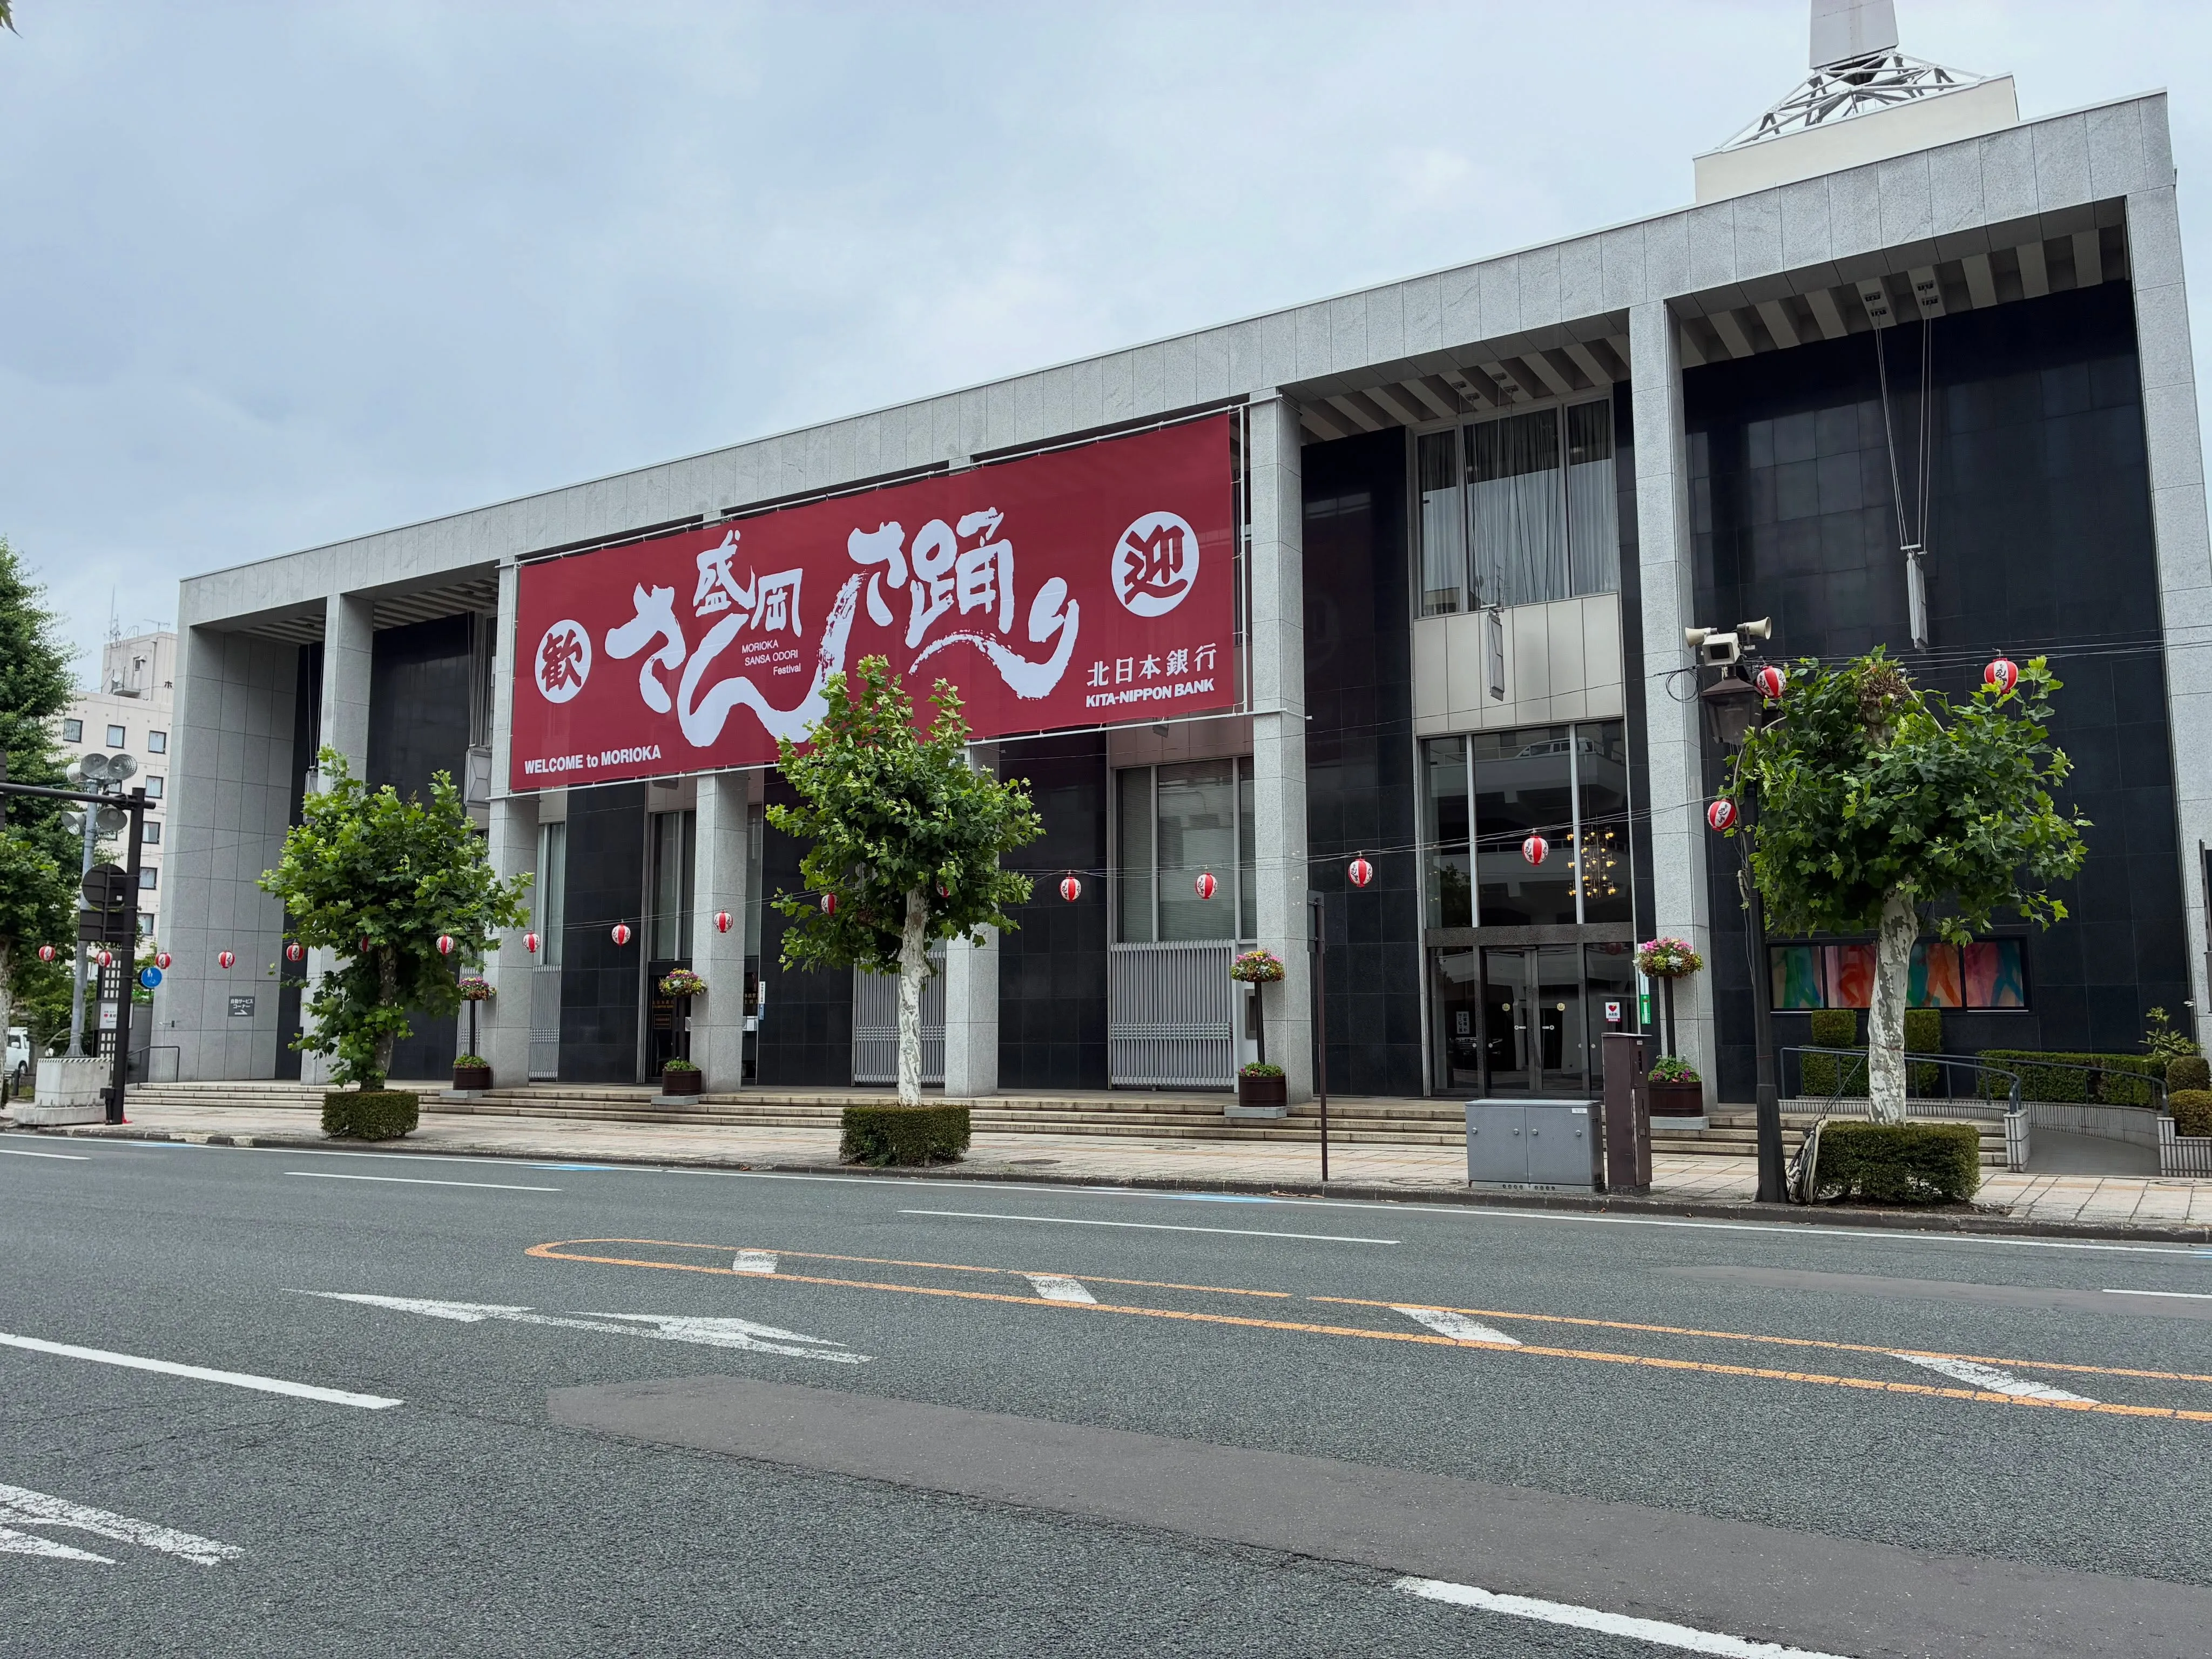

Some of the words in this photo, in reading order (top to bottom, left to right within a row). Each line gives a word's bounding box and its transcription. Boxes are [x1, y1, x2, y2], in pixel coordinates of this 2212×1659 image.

[1124, 524, 1188, 605] 迎
[693, 529, 803, 638] 盛岡
[541, 629, 583, 692] 歓
[741, 639, 779, 654] MORIOKA
[745, 653, 771, 666] SANSA
[772, 649, 798, 662] ODORI
[773, 663, 801, 676] Festival
[1086, 642, 1217, 687] 北日本銀行
[1085, 685, 1172, 708] KITA-NIPPON
[1174, 678, 1215, 697] BANK
[524, 754, 584, 774] WELCOME
[586, 754, 598, 768] to
[601, 744, 662, 766] MORIOKA
